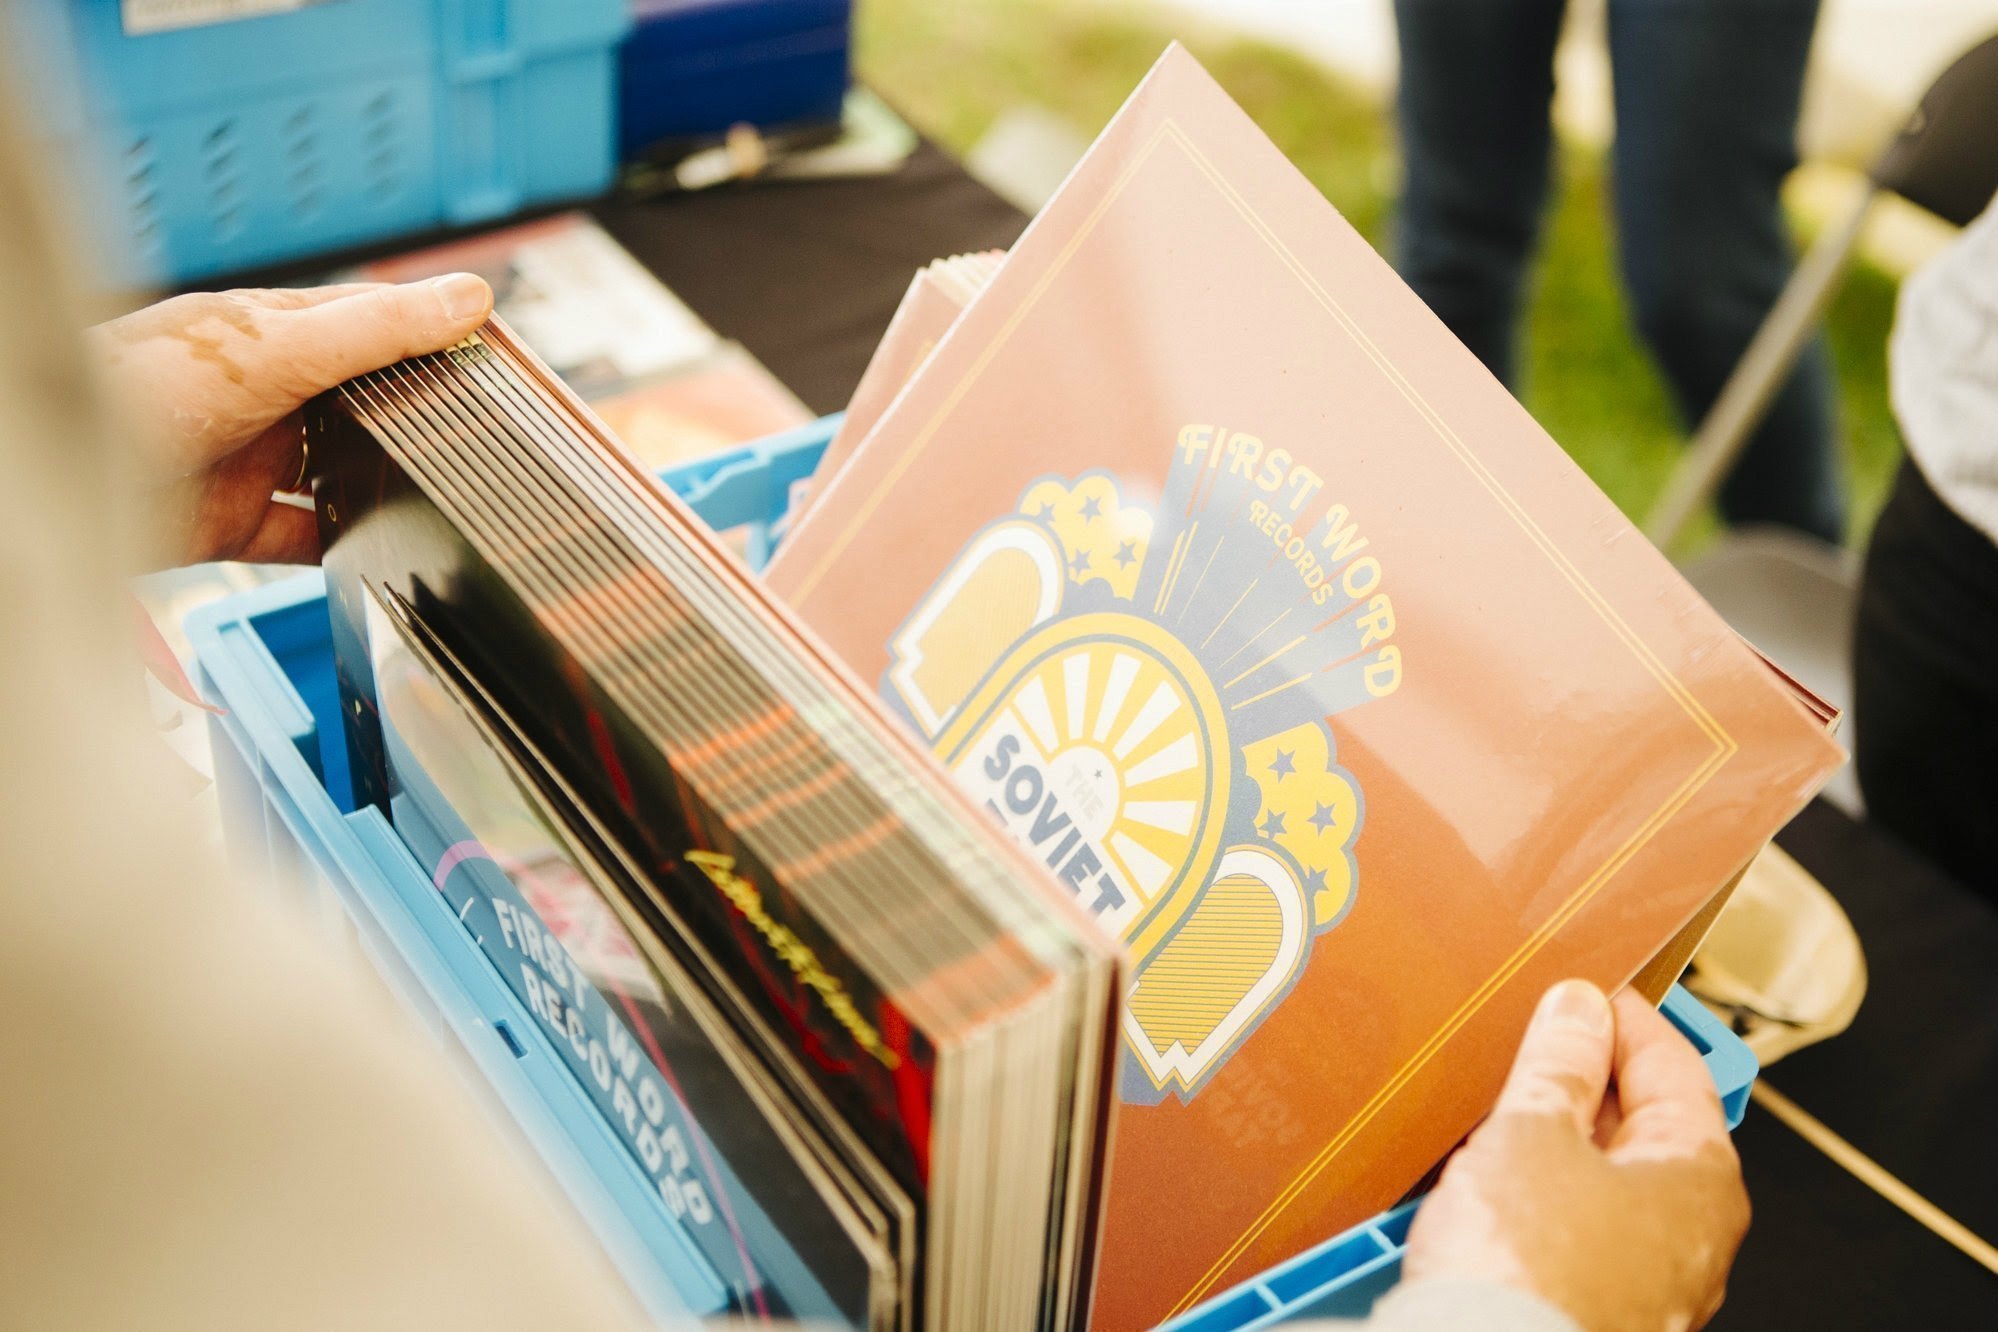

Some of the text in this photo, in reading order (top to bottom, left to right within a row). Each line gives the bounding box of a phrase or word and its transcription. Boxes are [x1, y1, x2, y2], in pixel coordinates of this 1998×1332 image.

[1177, 424, 1402, 697] FIRST WORD
[1249, 499, 1333, 605] RECORDS
[984, 734, 1126, 916] SOVIET
[1065, 763, 1105, 821] THE
[492, 898, 713, 1224] FIRST WORD
[519, 963, 685, 1221] RECORDS
